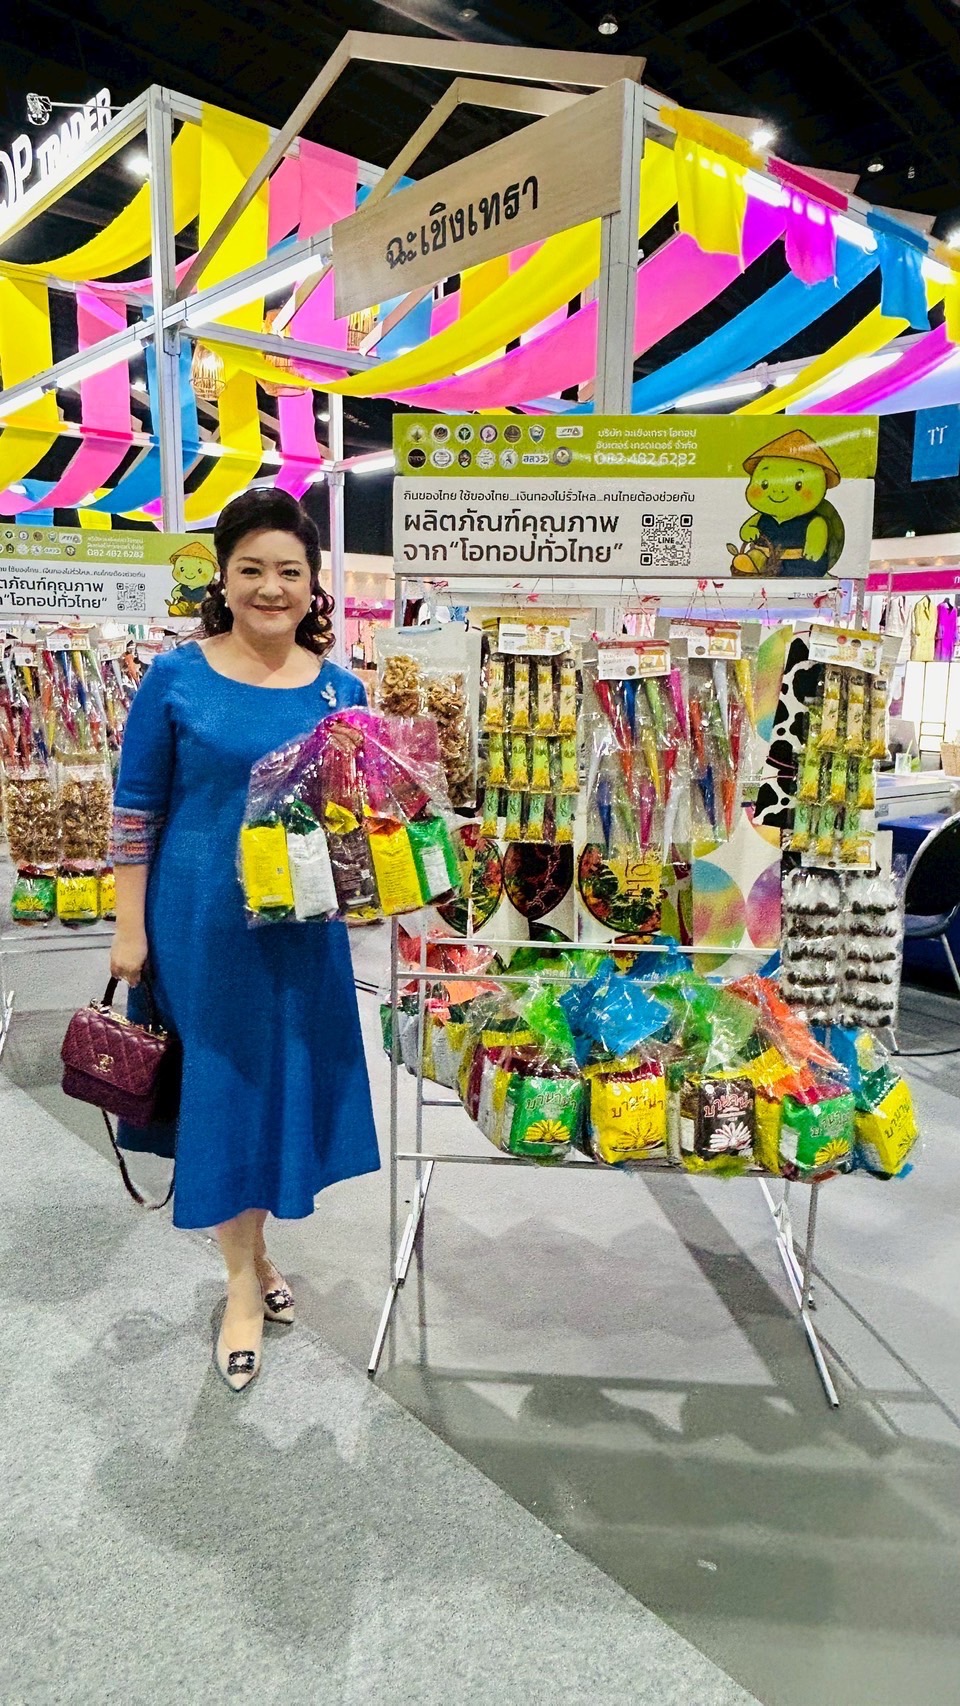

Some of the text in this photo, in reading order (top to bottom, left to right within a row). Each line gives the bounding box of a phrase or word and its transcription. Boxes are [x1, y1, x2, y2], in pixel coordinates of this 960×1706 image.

[37, 87, 112, 182] TRADER
[386, 175, 539, 269] ฉะเชิงเทรา
[403, 489, 457, 502] กินของไทย
[404, 508, 620, 539] ผลิตภัณฑ์คุณภาพ
